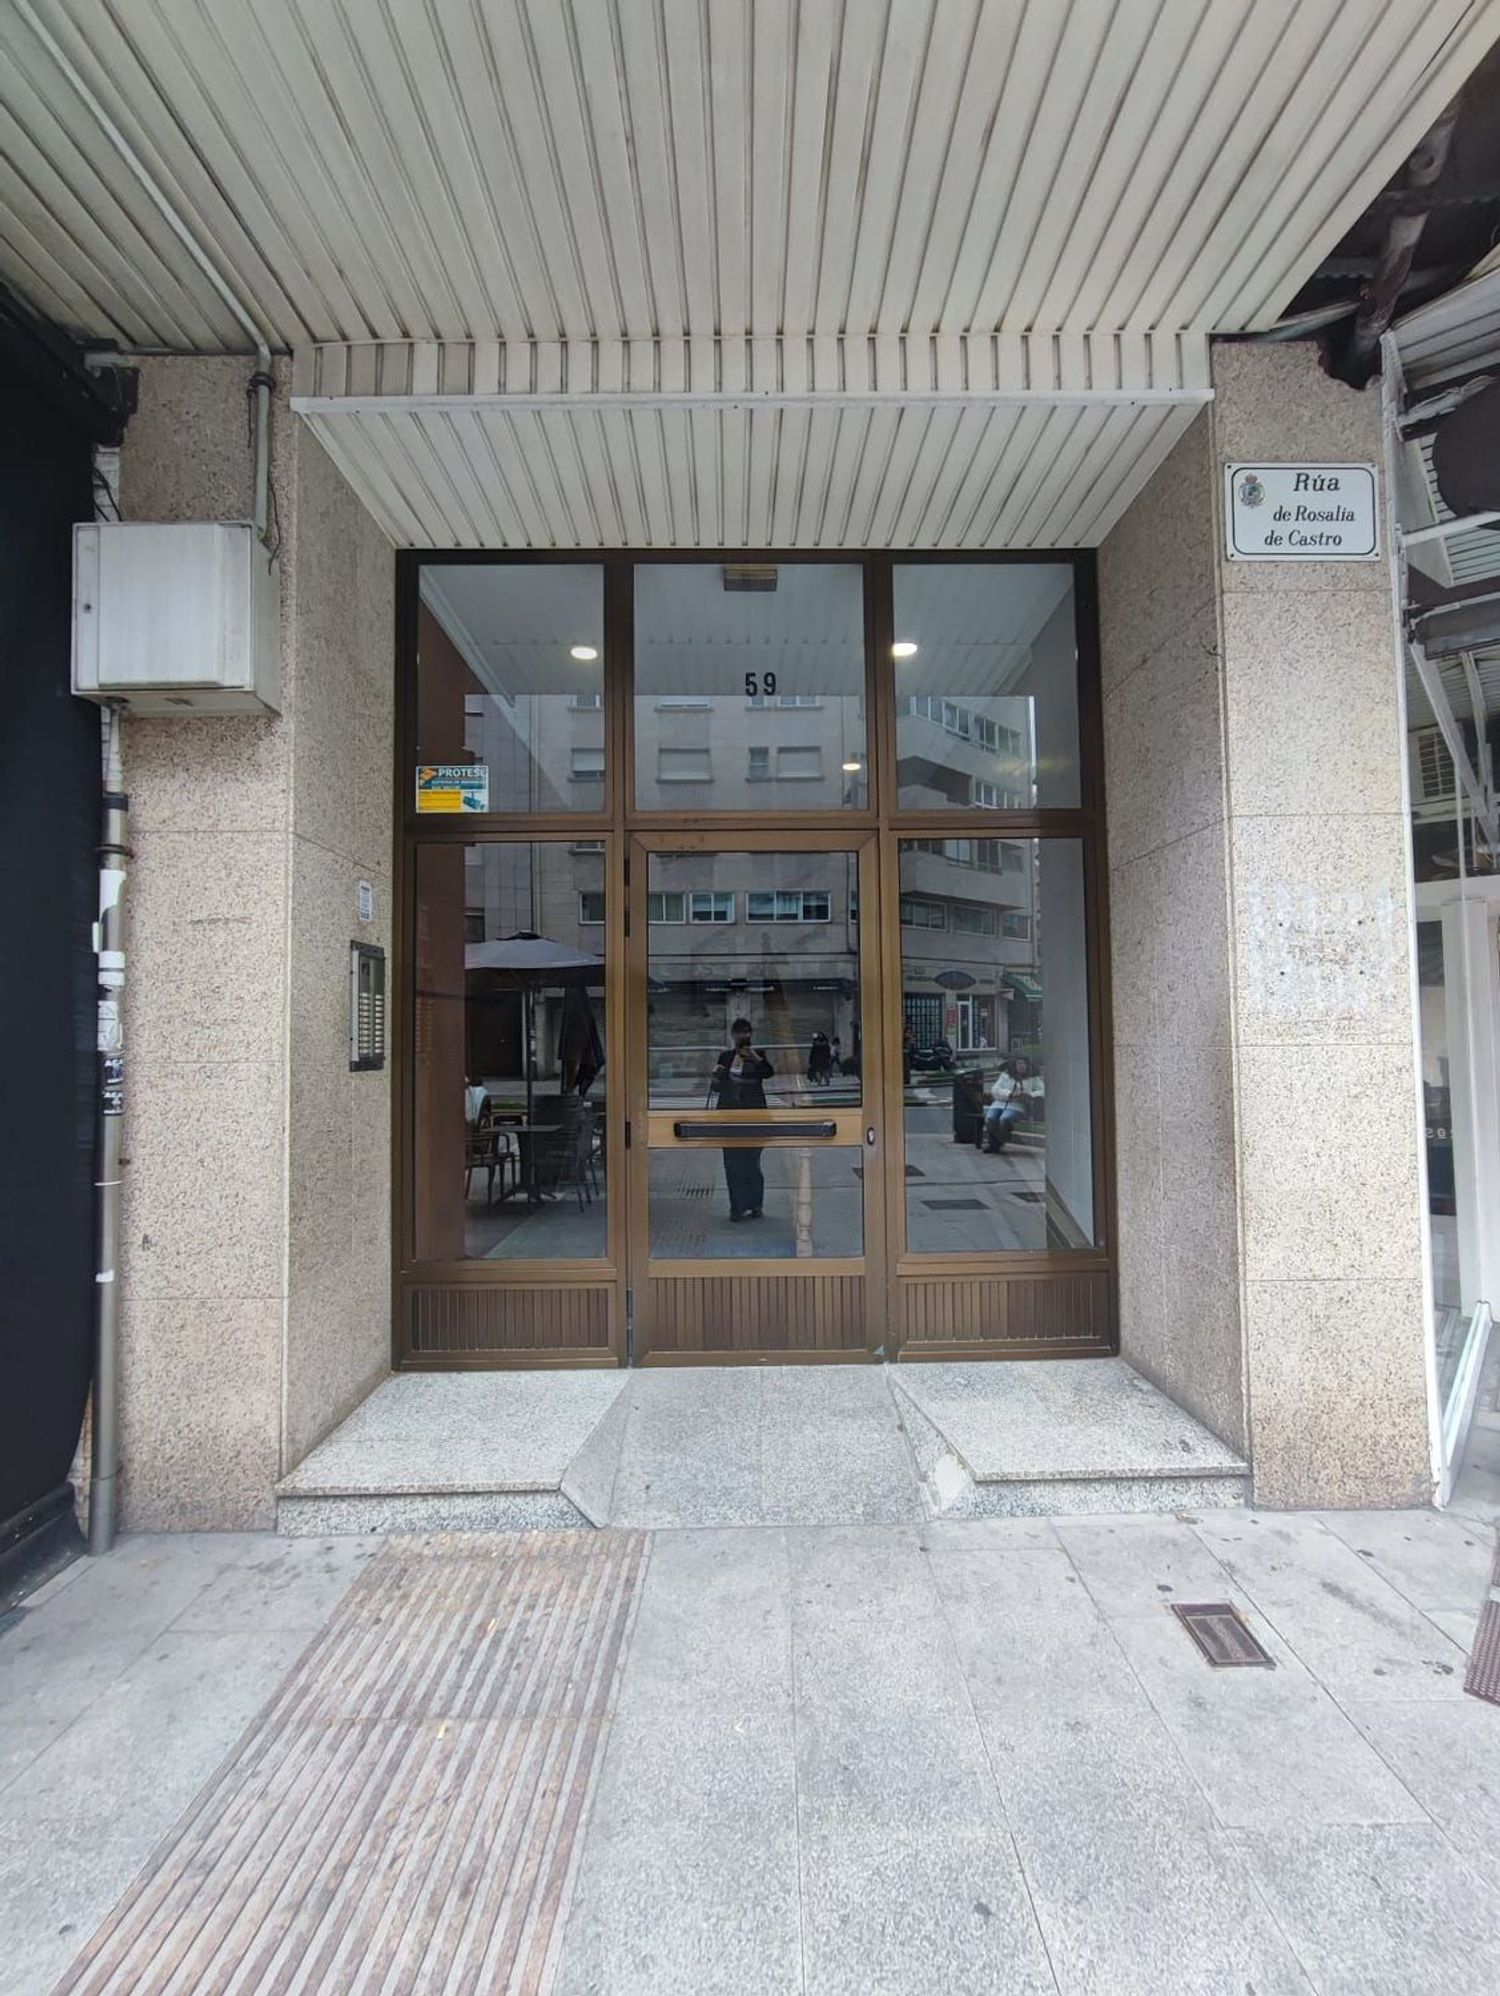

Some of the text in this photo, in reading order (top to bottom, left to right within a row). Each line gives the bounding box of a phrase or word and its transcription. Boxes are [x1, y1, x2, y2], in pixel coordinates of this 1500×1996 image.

[1293, 472, 1340, 492] Rúa
[1273, 505, 1291, 522] de
[1264, 529, 1342, 546] de Castro
[745, 671, 776, 697] 59
